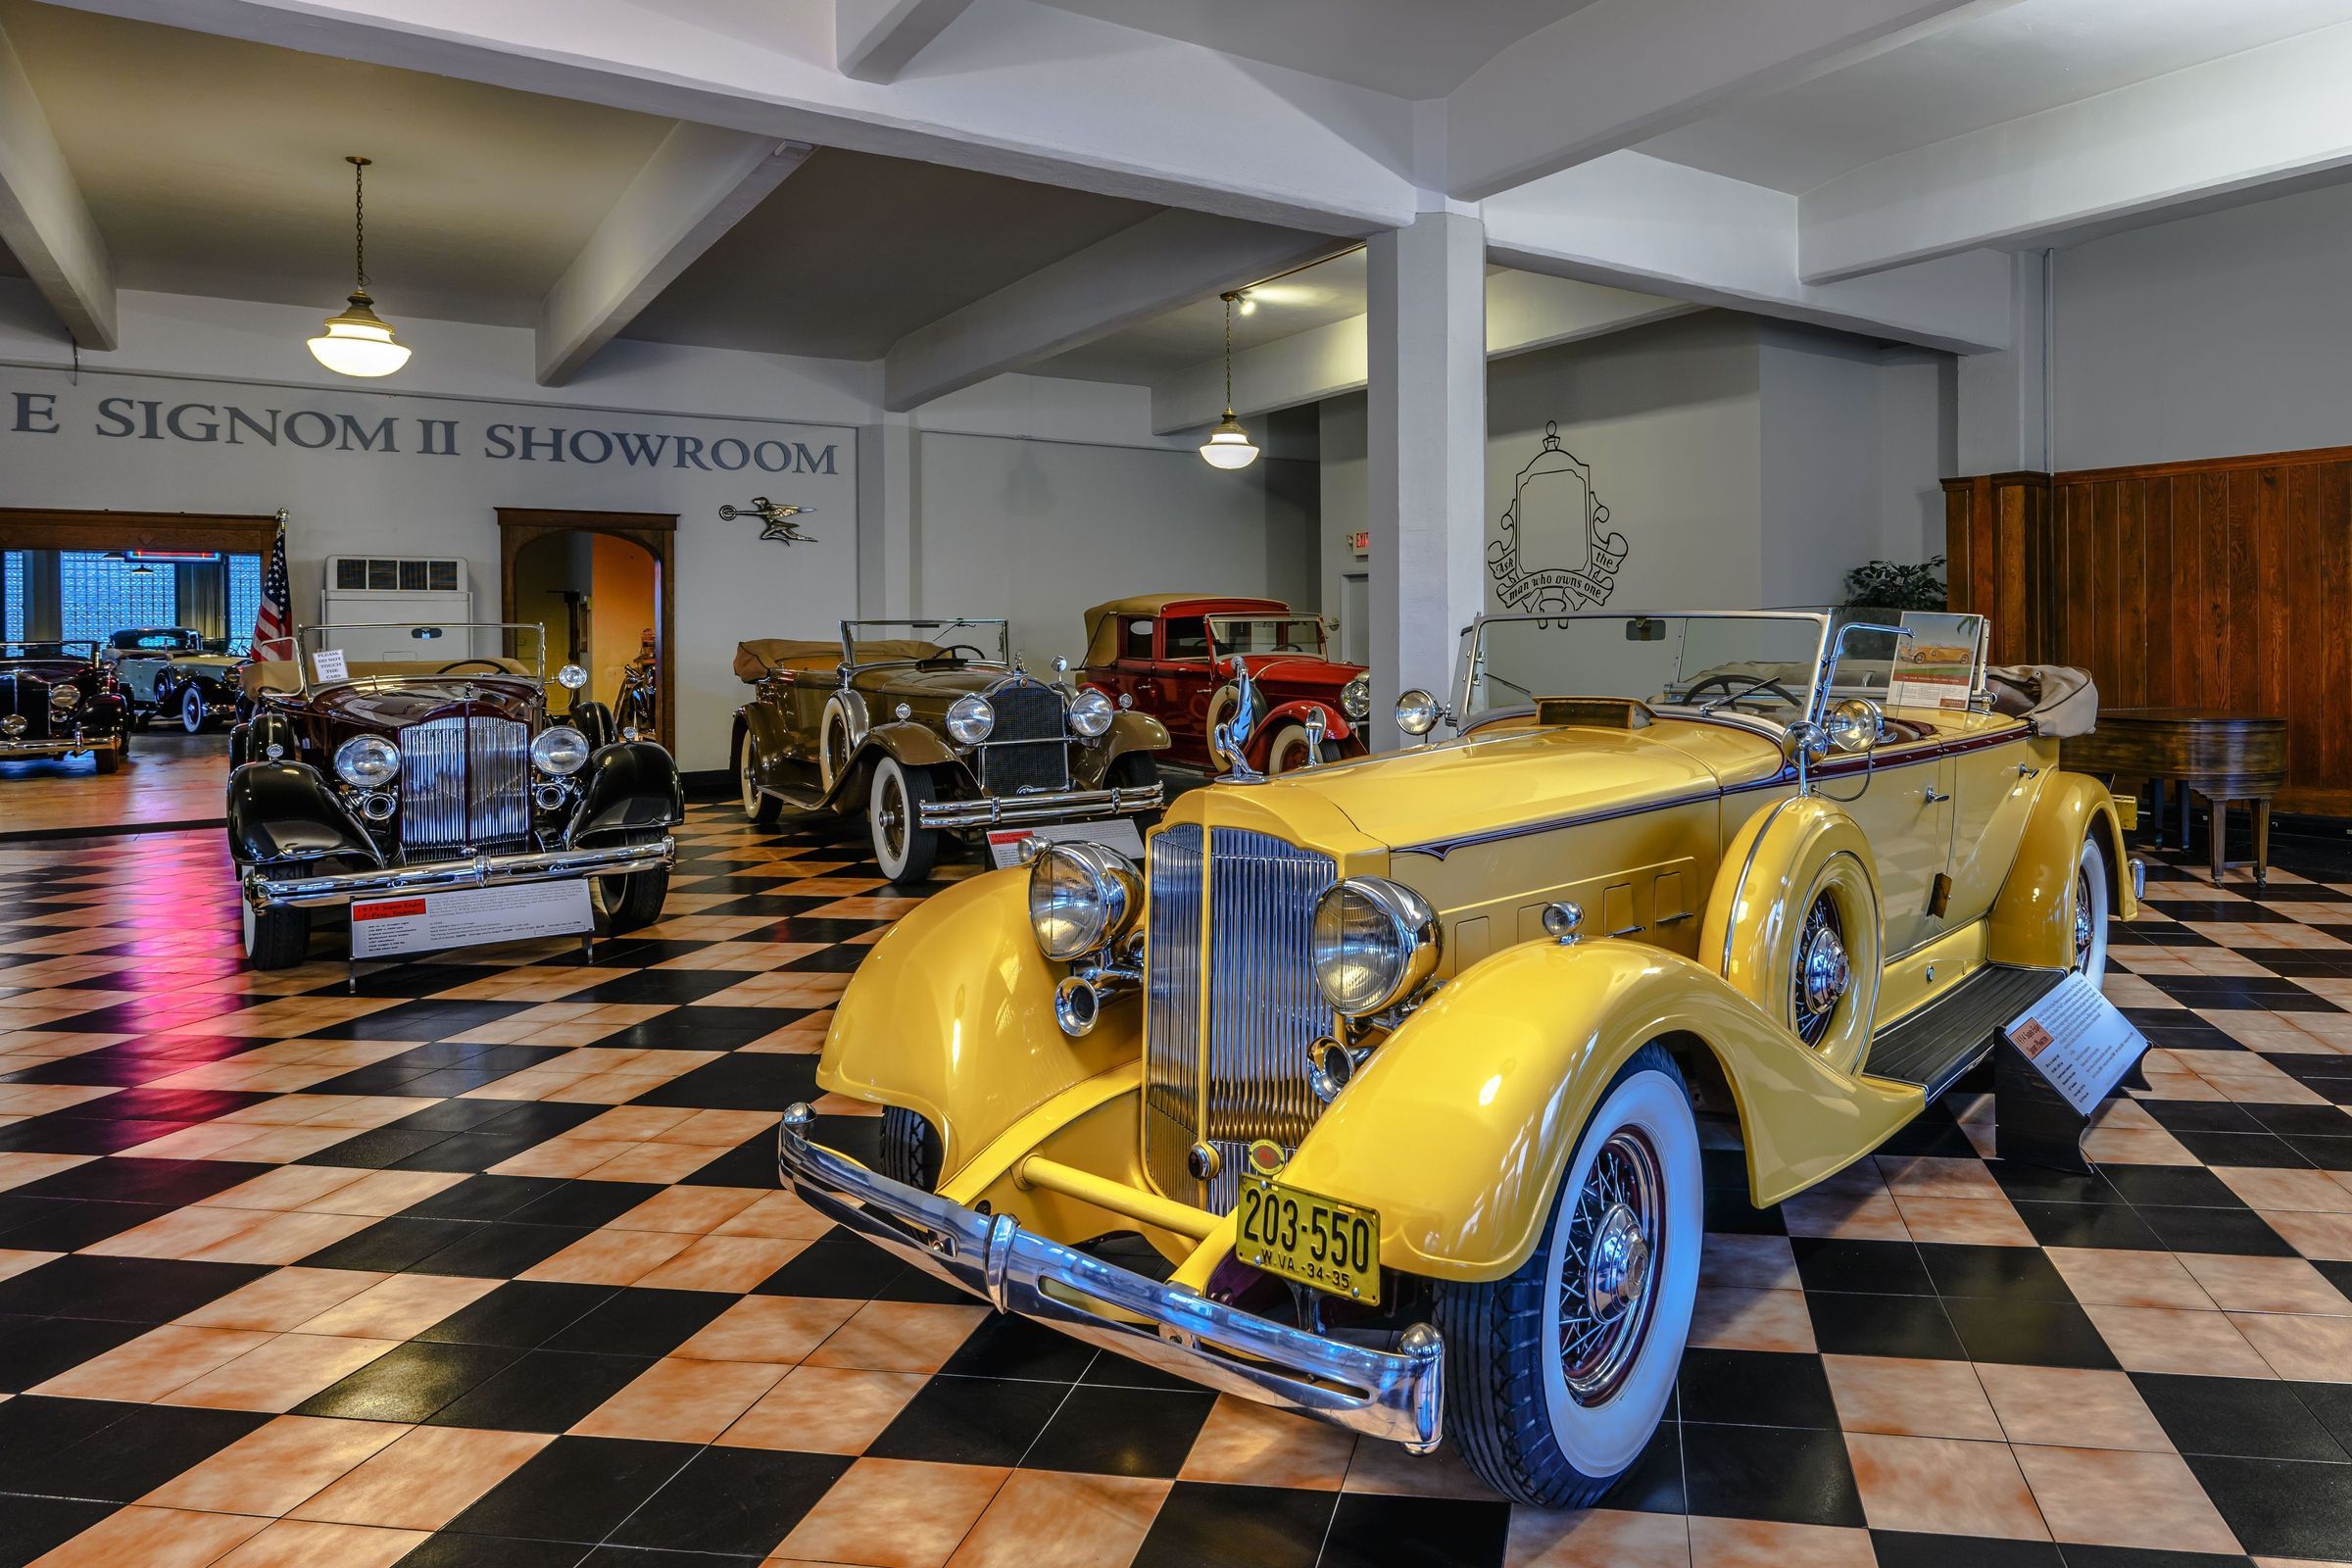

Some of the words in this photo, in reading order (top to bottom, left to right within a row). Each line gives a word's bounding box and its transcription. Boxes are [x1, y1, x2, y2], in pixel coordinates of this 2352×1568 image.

[10, 391, 61, 434] E
[95, 396, 401, 454] SIGNOM
[416, 418, 462, 457] II
[484, 422, 840, 475] SHOWROOM
[1495, 557, 1514, 574] Ask
[1595, 552, 1613, 568] the
[1508, 581, 1530, 602] man
[1531, 573, 1552, 588] who
[1554, 573, 1583, 588] owns
[1584, 582, 1601, 599] one
[1244, 1188, 1370, 1274] 203-550
